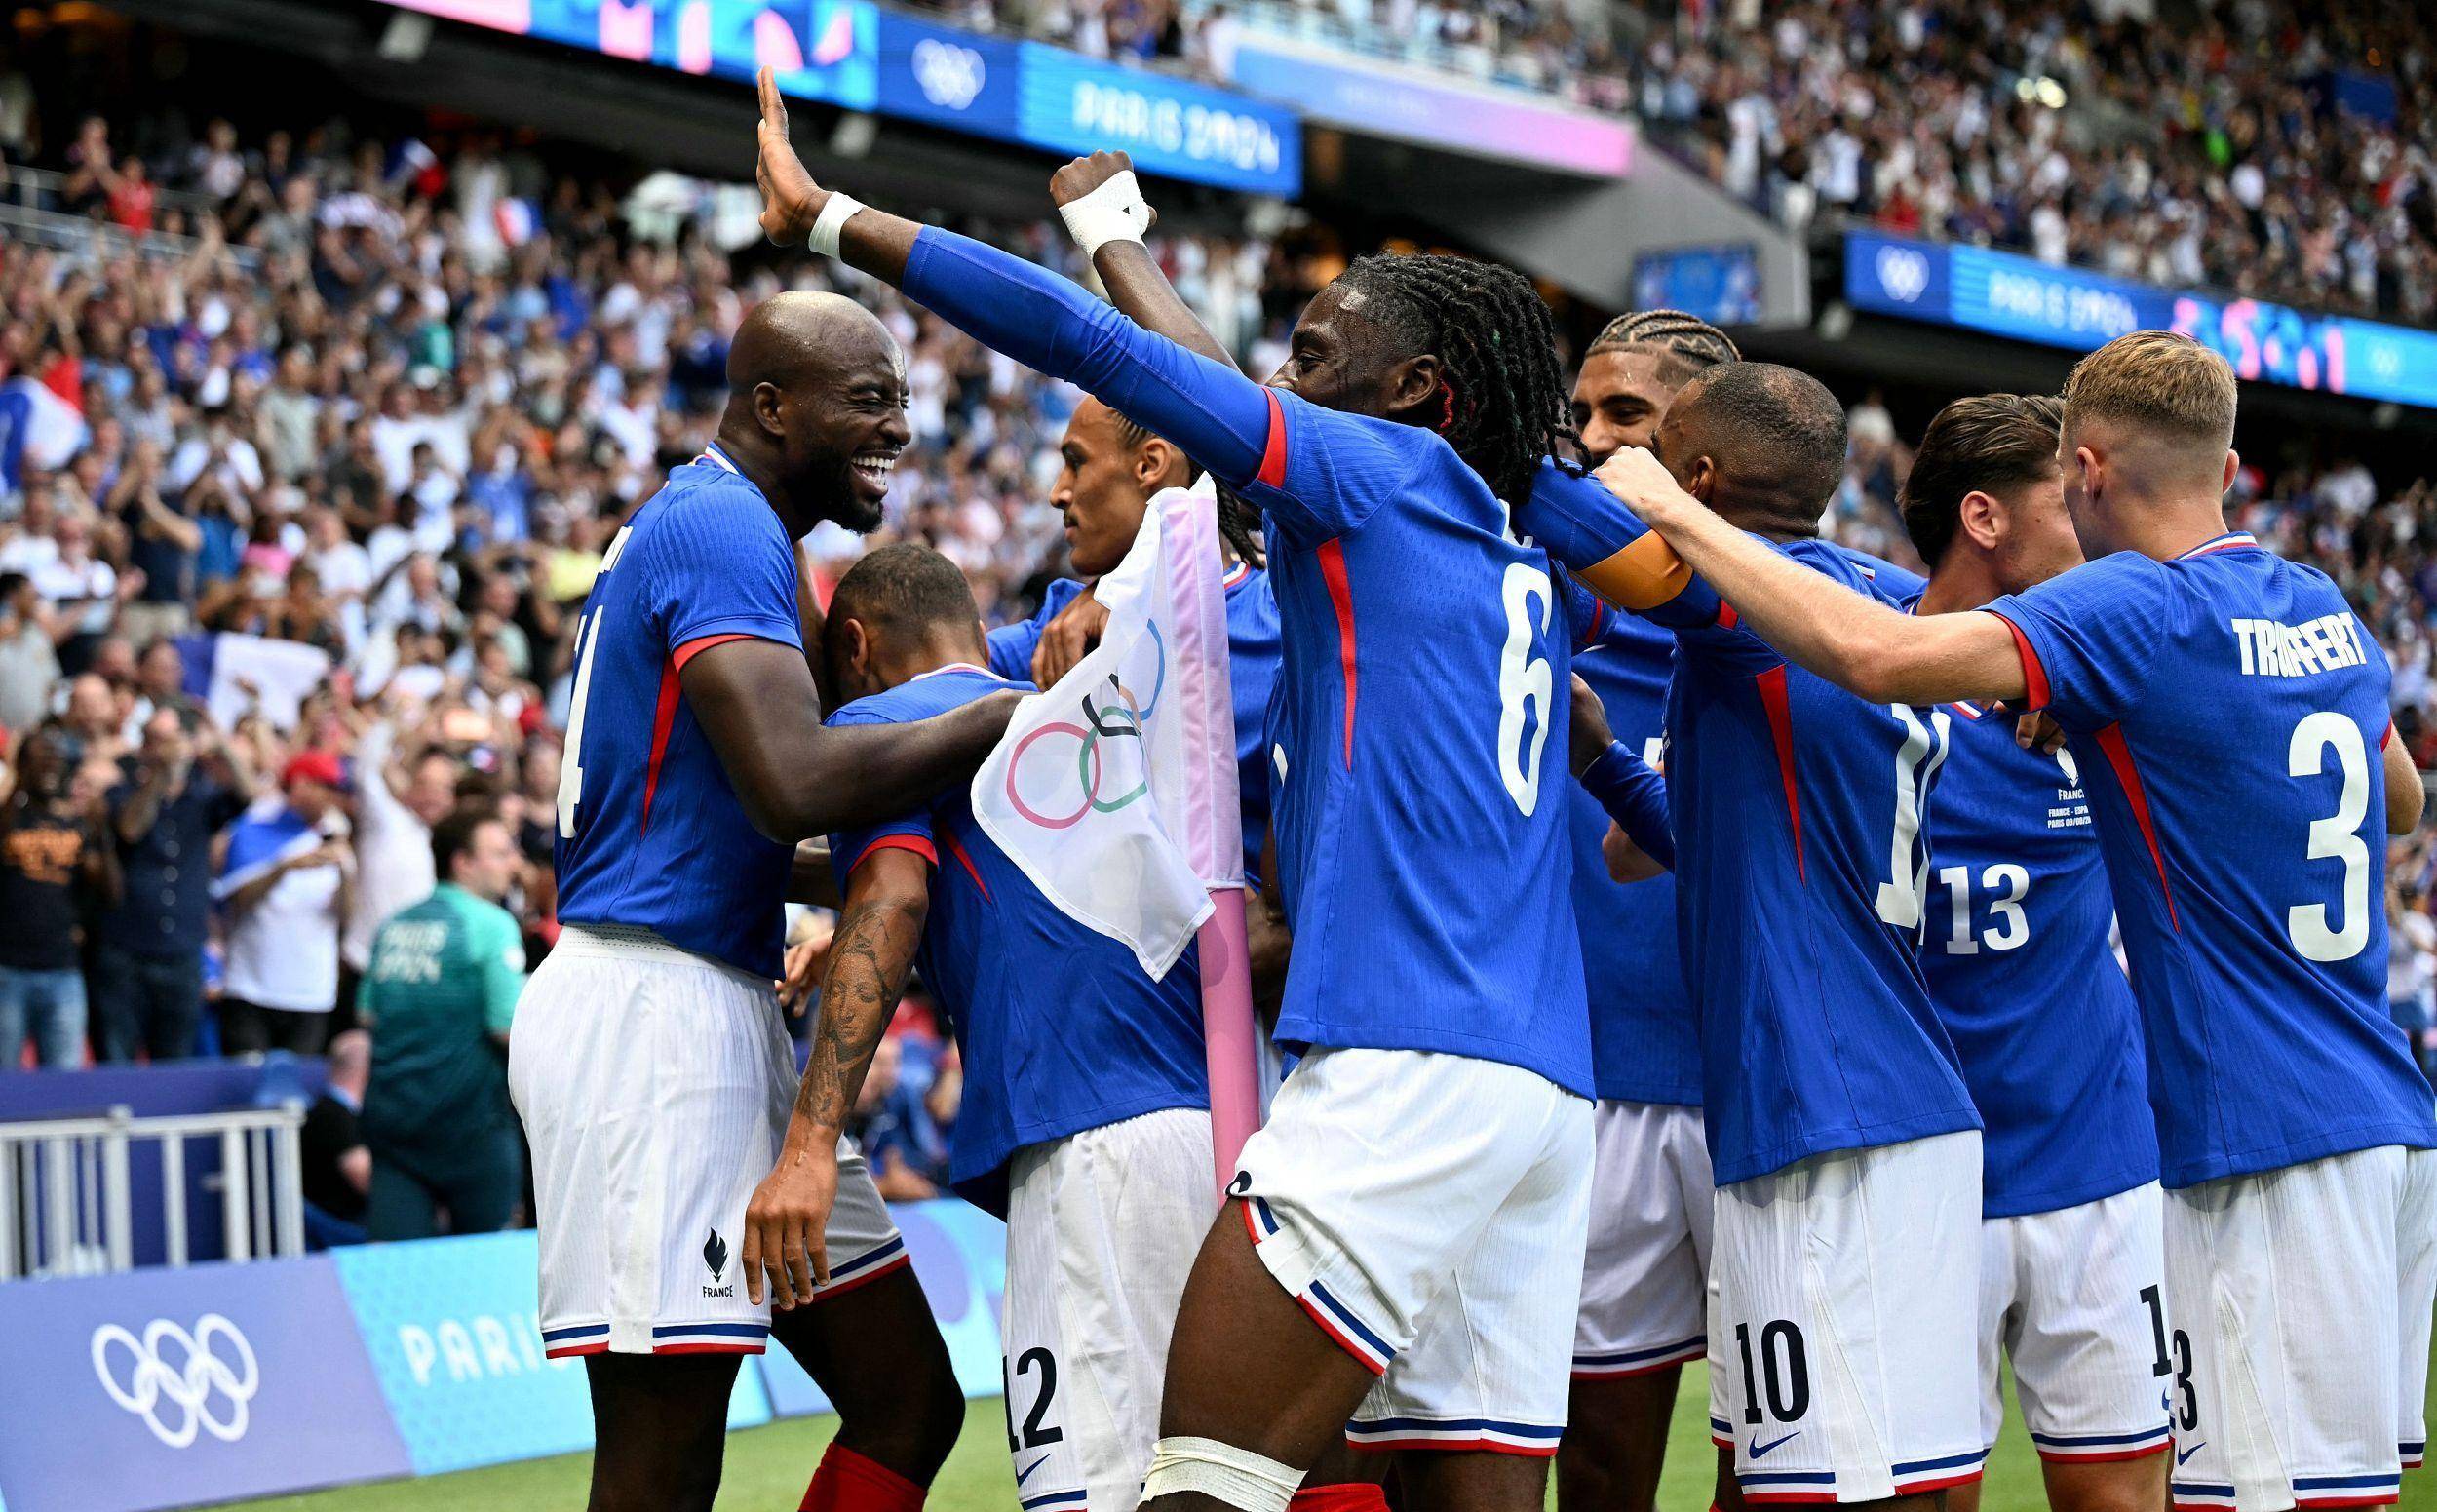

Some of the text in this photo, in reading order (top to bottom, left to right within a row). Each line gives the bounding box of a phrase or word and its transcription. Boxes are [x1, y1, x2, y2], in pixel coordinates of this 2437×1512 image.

[1073, 81, 1280, 174] PARIS 2024
[1498, 562, 1553, 817] 6
[2047, 819, 2065, 829] PARIS
[2048, 807, 2070, 818] FRANCE
[2058, 788, 2085, 801] FRANC
[2288, 711, 2370, 962] 3
[1940, 864, 2030, 955] 13
[702, 1284, 733, 1298] FRANCE
[398, 1312, 573, 1388] PARI
[1735, 1320, 1810, 1424] 10
[2173, 1329, 2198, 1432] 3
[1002, 1346, 1064, 1454] 12
